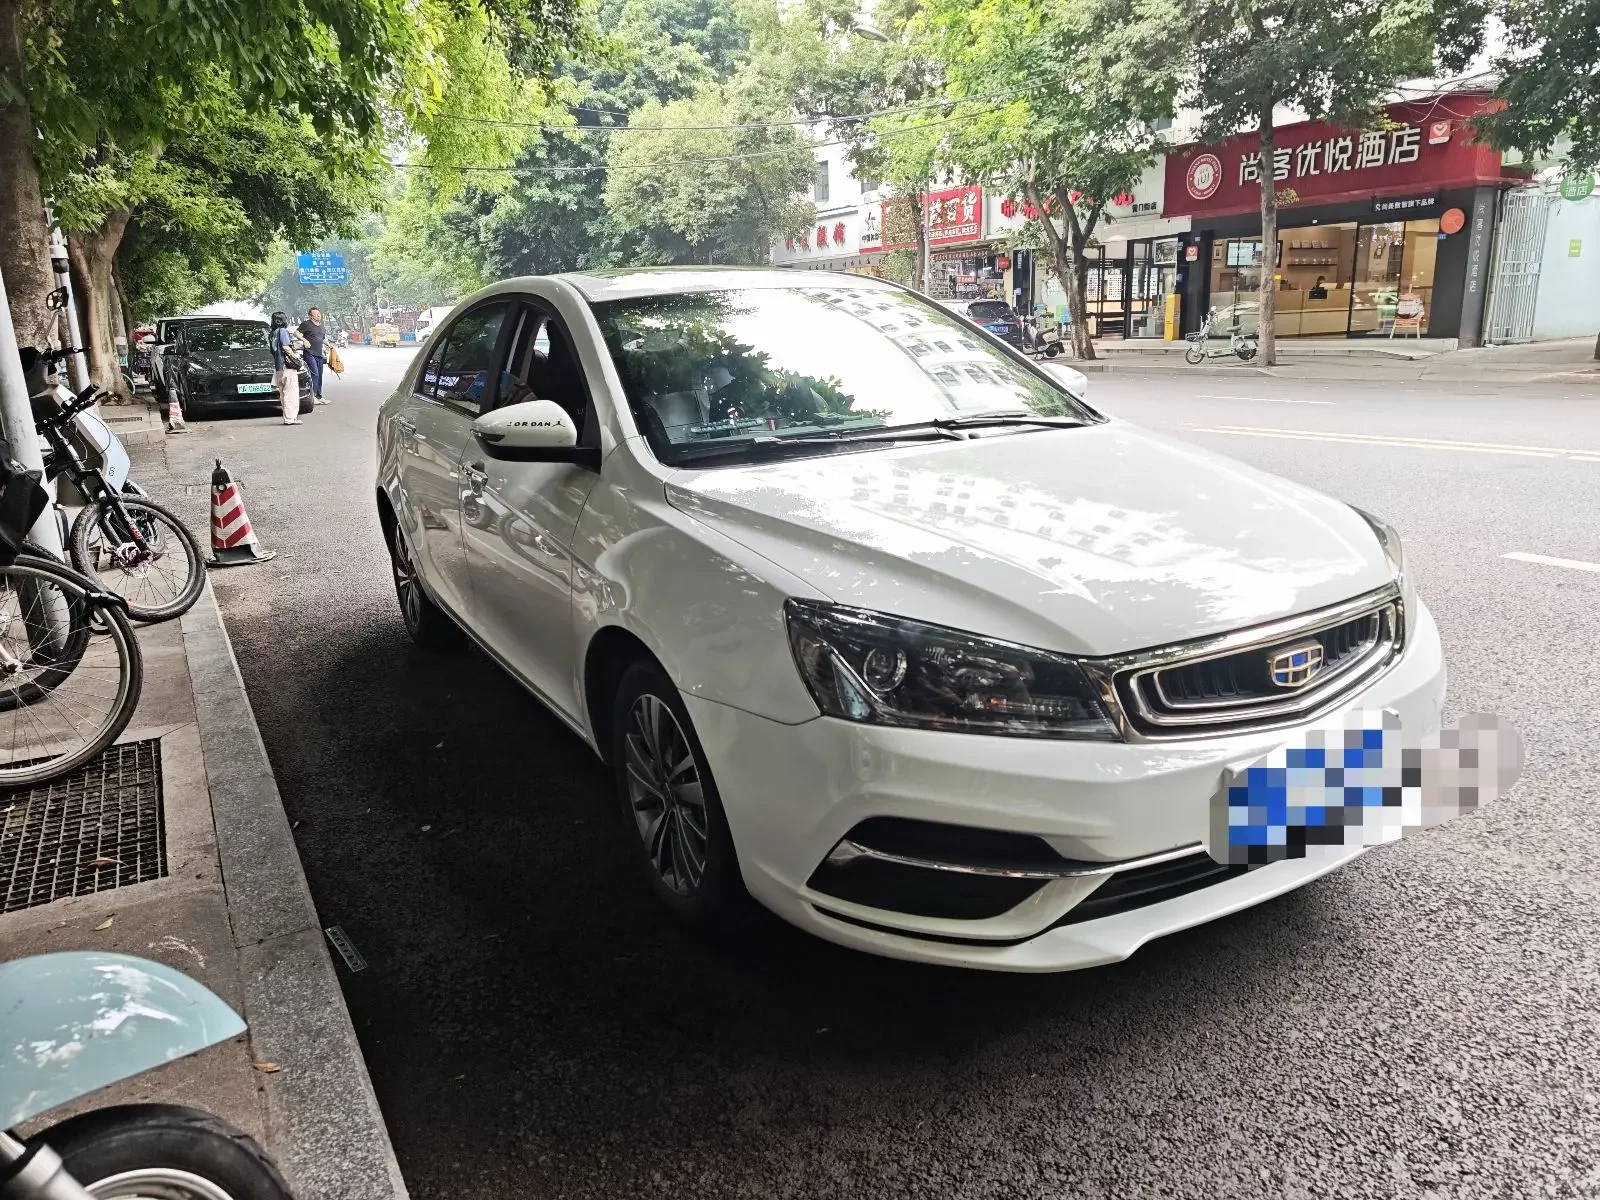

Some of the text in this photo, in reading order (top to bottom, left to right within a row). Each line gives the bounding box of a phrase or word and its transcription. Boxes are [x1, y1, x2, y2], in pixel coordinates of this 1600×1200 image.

[1239, 127, 1421, 186] 尚客优悦酒店
